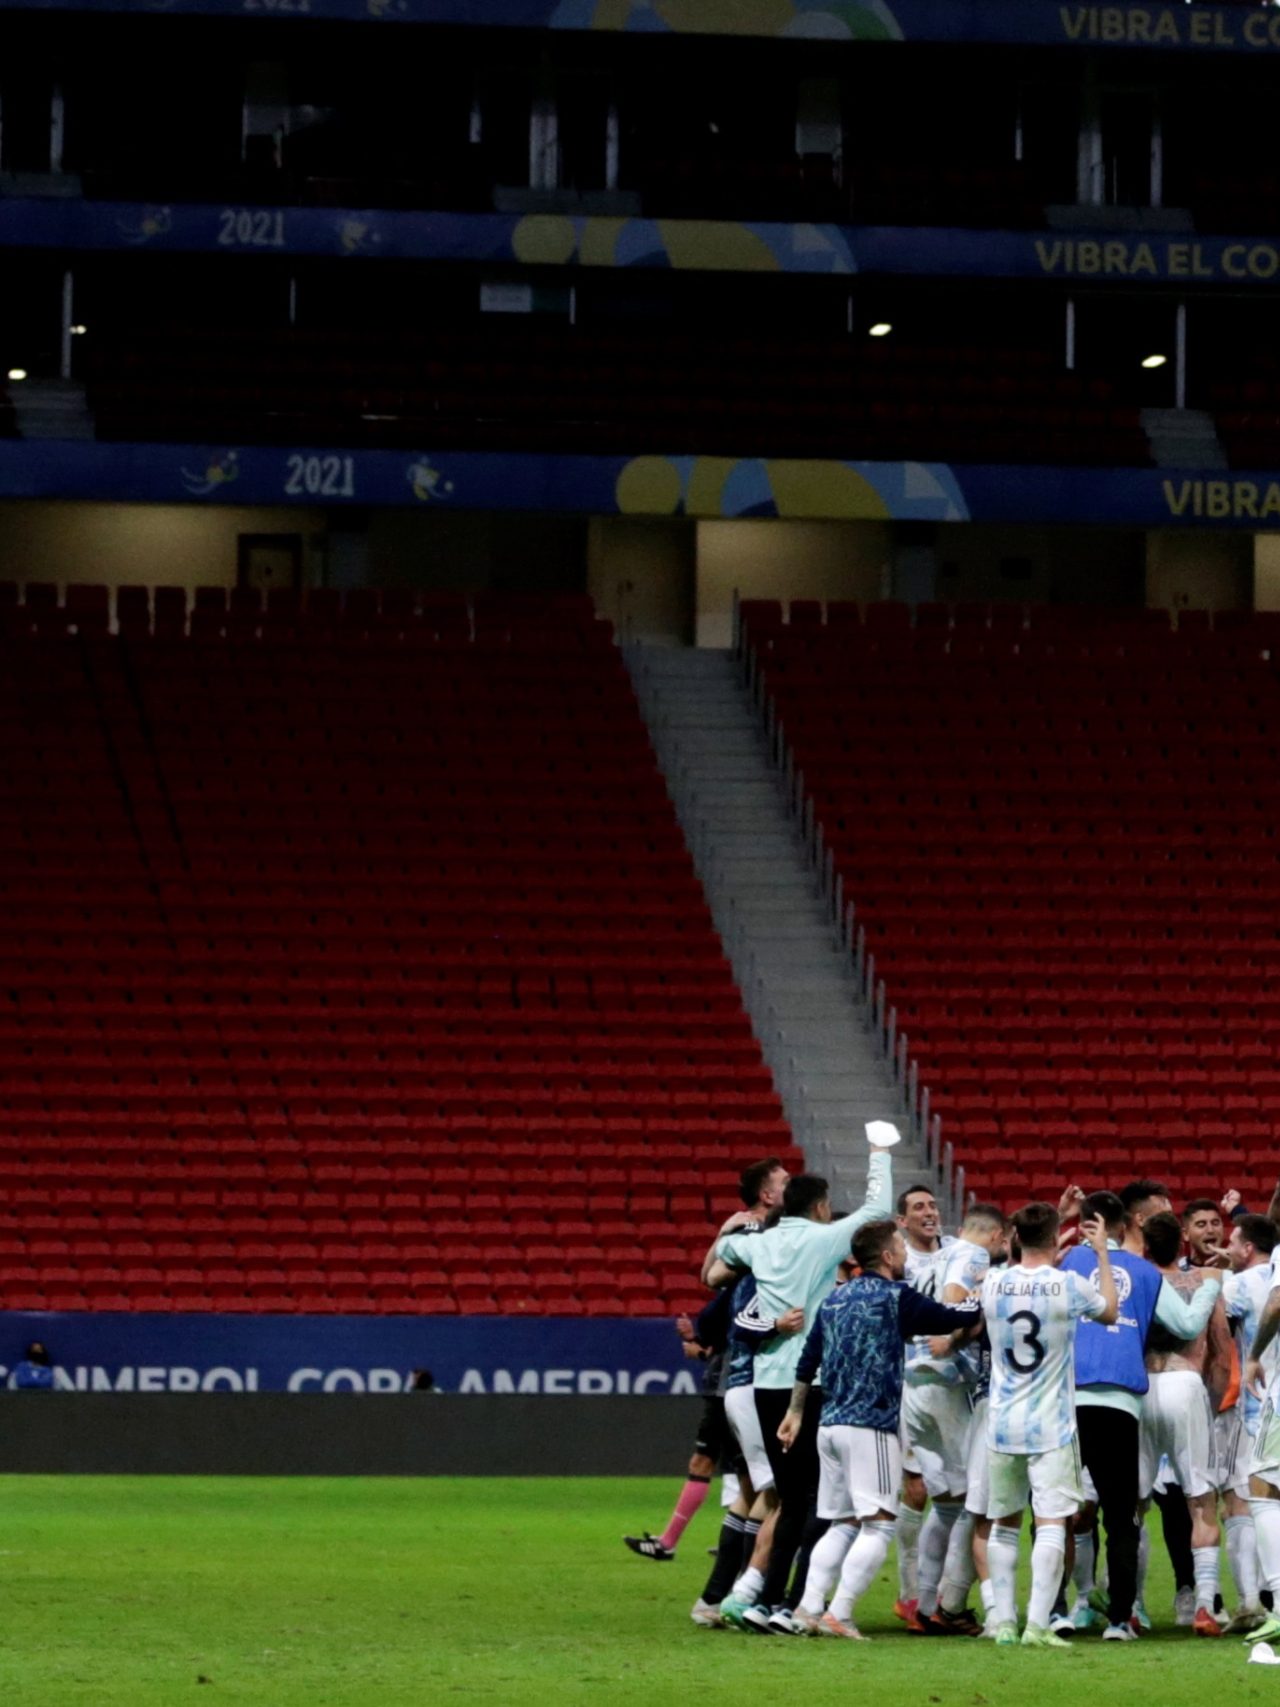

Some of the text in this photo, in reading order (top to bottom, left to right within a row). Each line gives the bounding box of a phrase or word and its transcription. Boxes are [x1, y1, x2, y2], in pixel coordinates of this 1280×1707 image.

[1060, 7, 1179, 42] VIBRA
[1190, 12, 1233, 44] EL
[218, 211, 284, 246] 2021
[1035, 240, 1156, 273] VIBRA
[1168, 244, 1212, 275] EL
[285, 455, 354, 496] 2021
[1005, 1310, 1045, 1374] 3
[288, 1368, 416, 1393] COP
